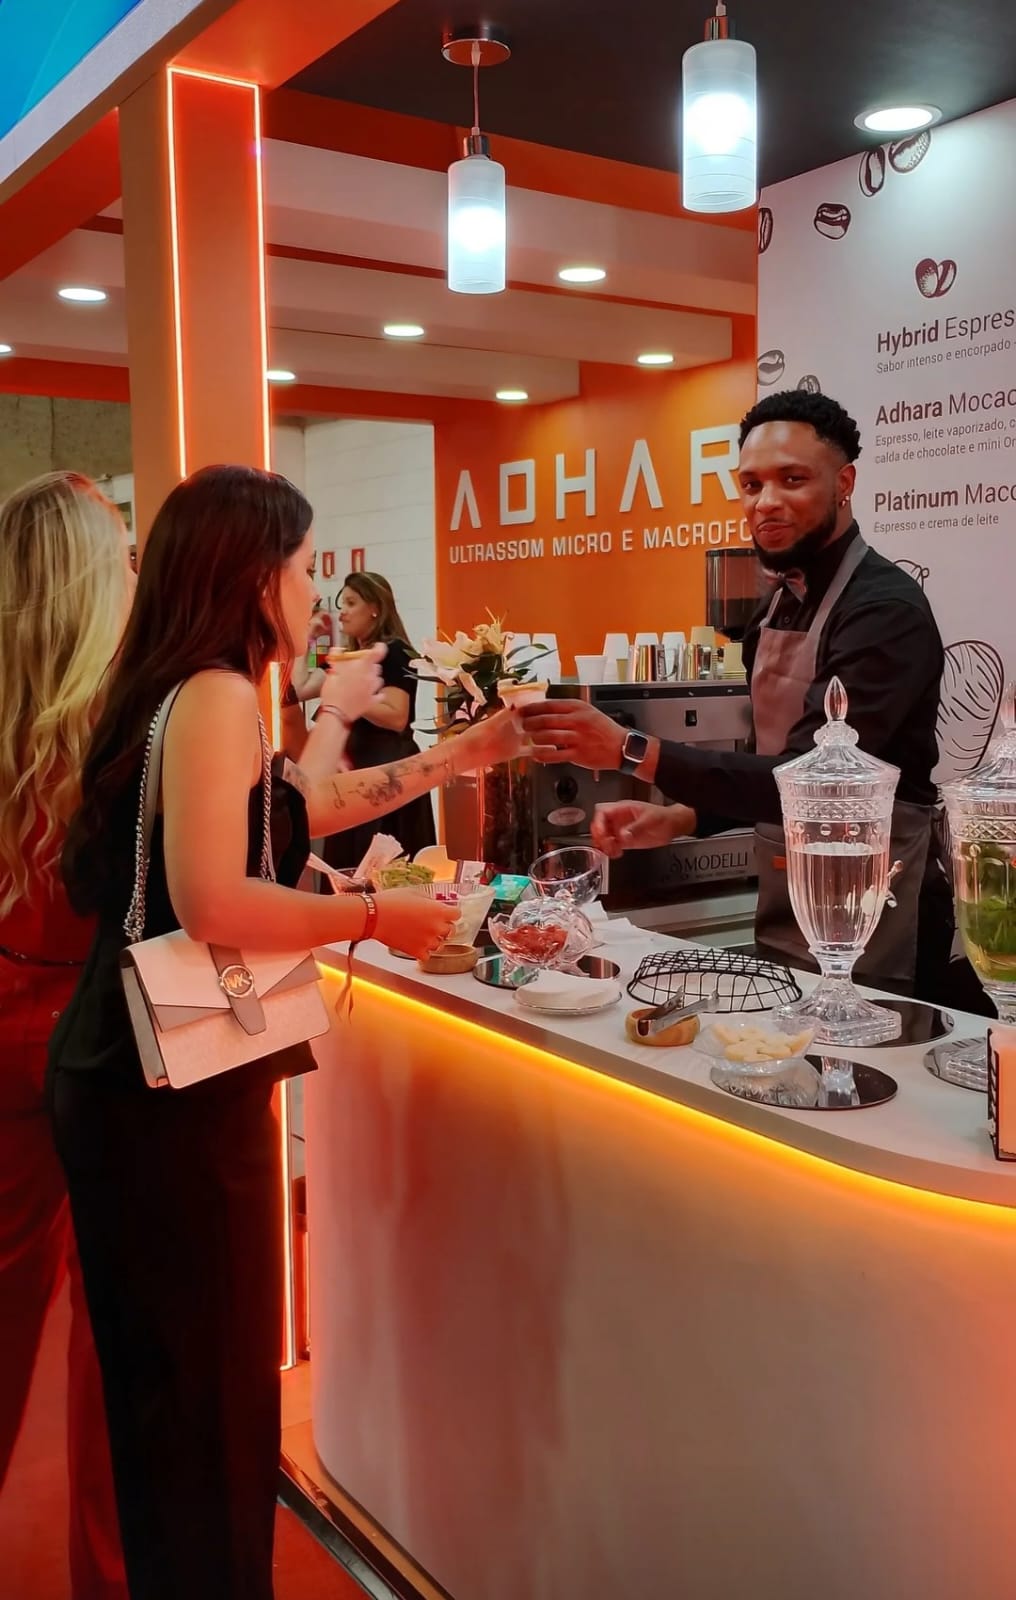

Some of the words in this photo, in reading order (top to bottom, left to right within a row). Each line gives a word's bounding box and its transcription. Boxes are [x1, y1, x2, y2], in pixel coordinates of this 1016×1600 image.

[877, 320, 939, 356] Hybrid
[945, 309, 1015, 340] Espres
[876, 360, 904, 374] Sabor
[907, 353, 943, 369] intenso
[946, 351, 952, 361] e
[955, 338, 1011, 358] encorpado
[875, 400, 943, 426] Adhara
[875, 431, 921, 448] Espresso,
[923, 428, 944, 441] leite
[946, 418, 1007, 437] vaporizado,
[875, 451, 900, 464] calda
[903, 449, 915, 461] de
[917, 443, 966, 459] chocolate
[968, 443, 975, 453] e
[978, 436, 1000, 451] mini
[450, 423, 740, 531] ADHAR
[875, 489, 959, 513] Platinum
[873, 521, 917, 534] Espresso
[920, 519, 925, 529] e
[927, 518, 959, 529] crema
[961, 514, 974, 527] de
[976, 512, 999, 526] leite
[450, 538, 544, 564] ULTRASSOM
[552, 532, 612, 557] MICRO
[622, 530, 633, 551] E
[684, 852, 748, 872] MODELLI
